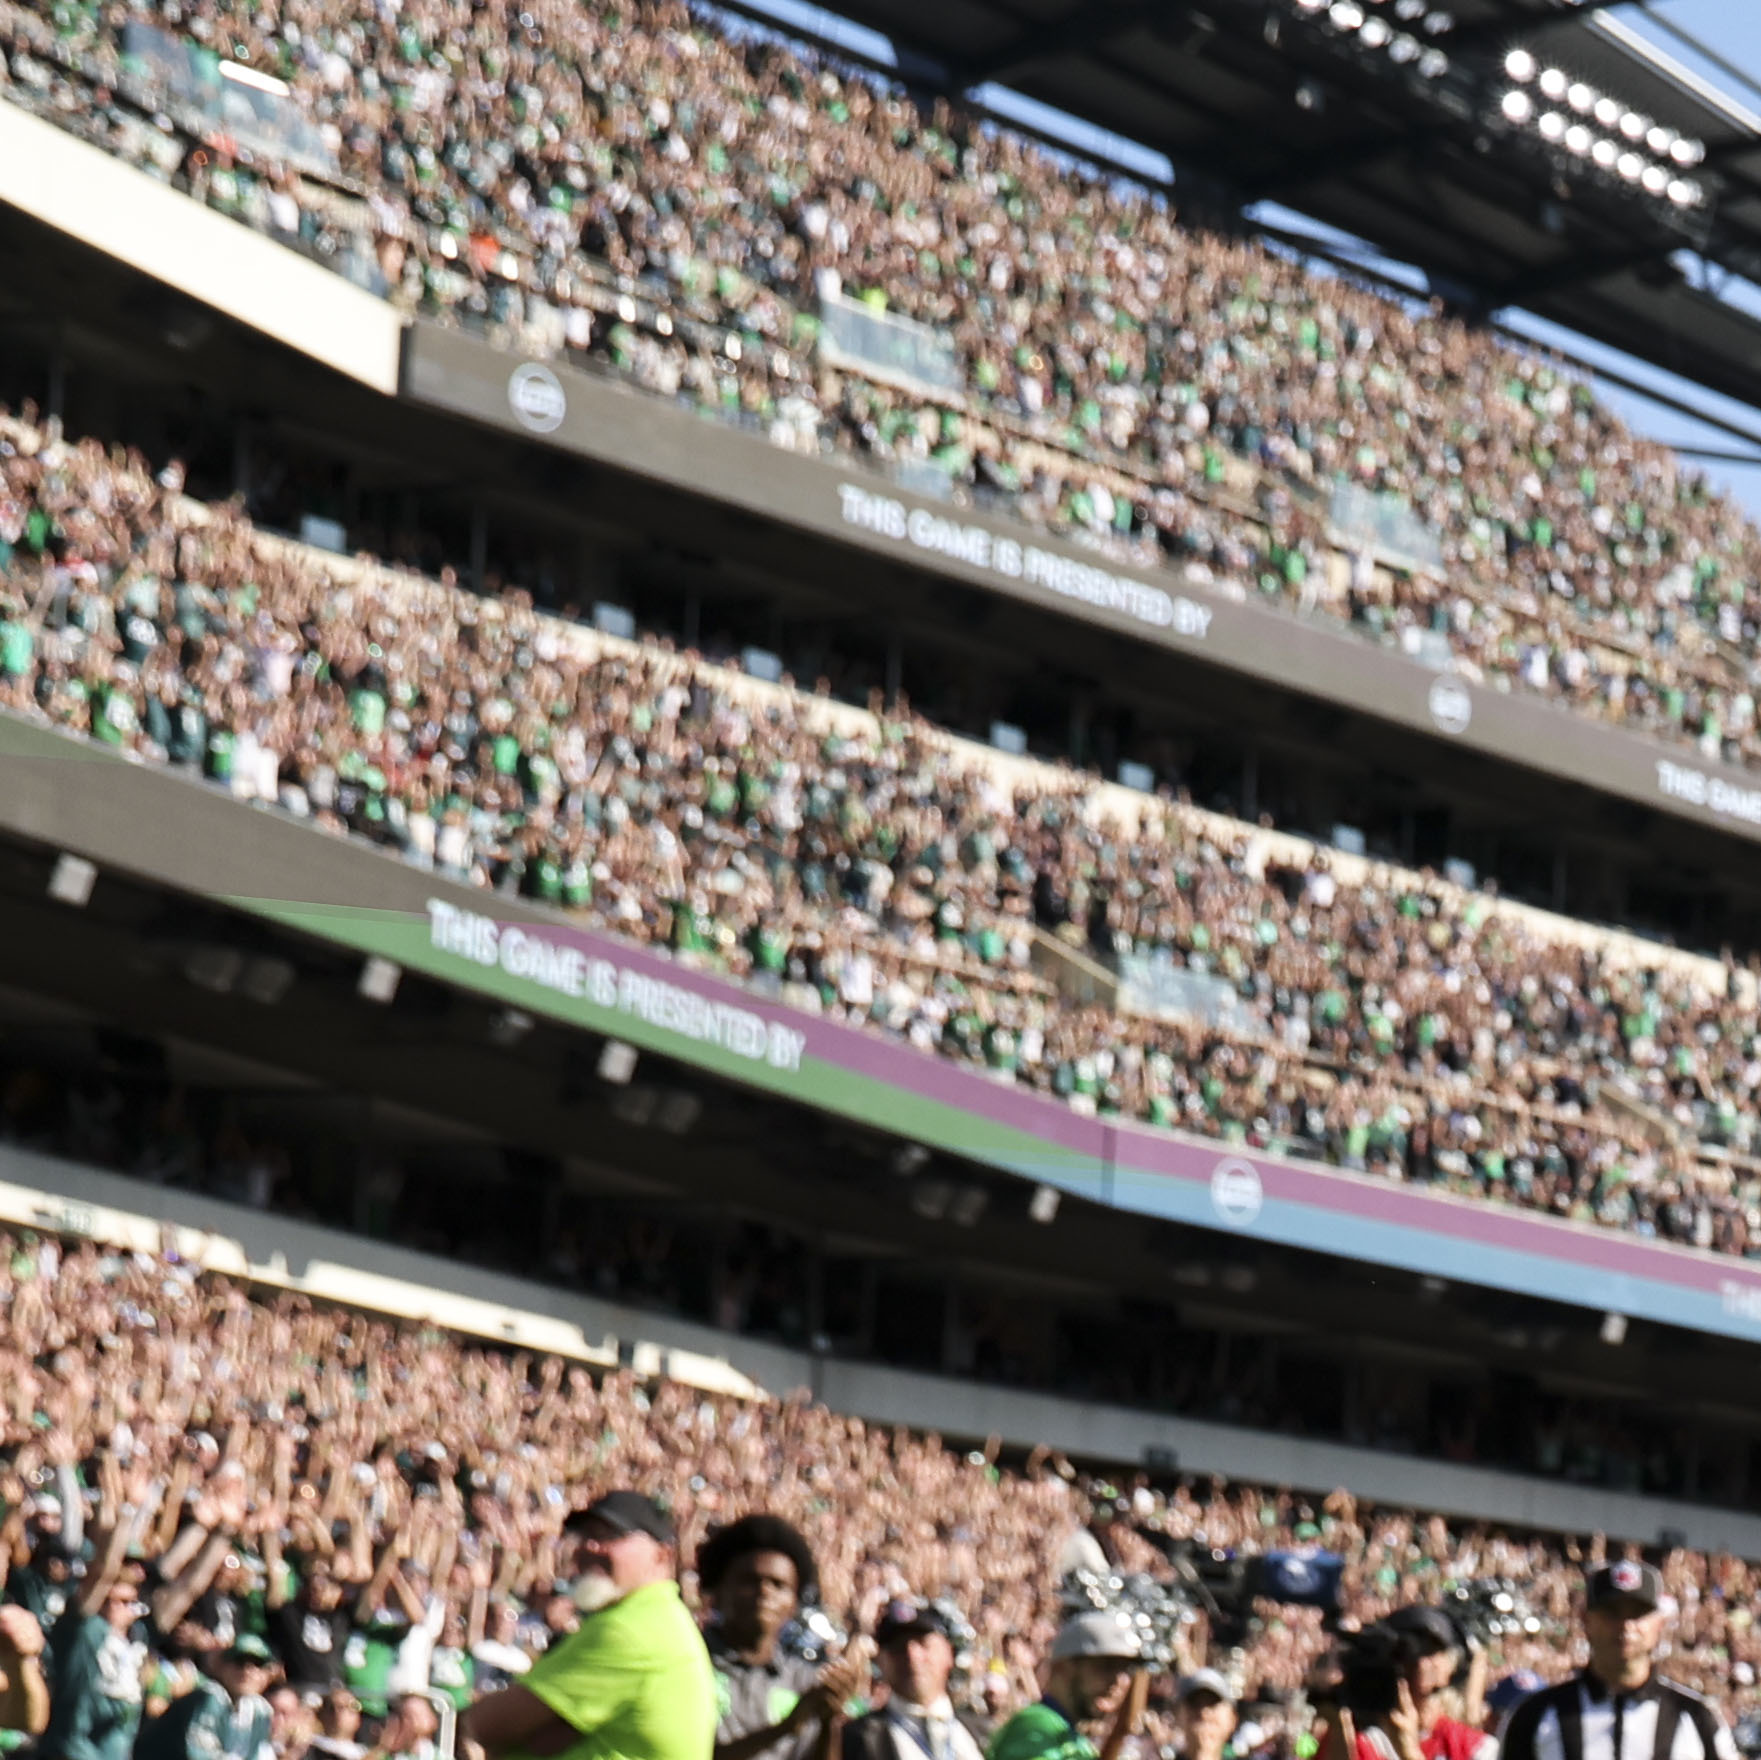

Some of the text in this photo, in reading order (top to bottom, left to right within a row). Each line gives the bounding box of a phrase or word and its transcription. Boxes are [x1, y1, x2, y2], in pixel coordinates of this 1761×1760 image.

[838, 483, 906, 539] THIS
[907, 508, 992, 568] GAME
[992, 535, 1023, 578] IS
[1173, 595, 1213, 639] BY
[426, 896, 806, 1073] THIS GAME IS PRESENTED BY
